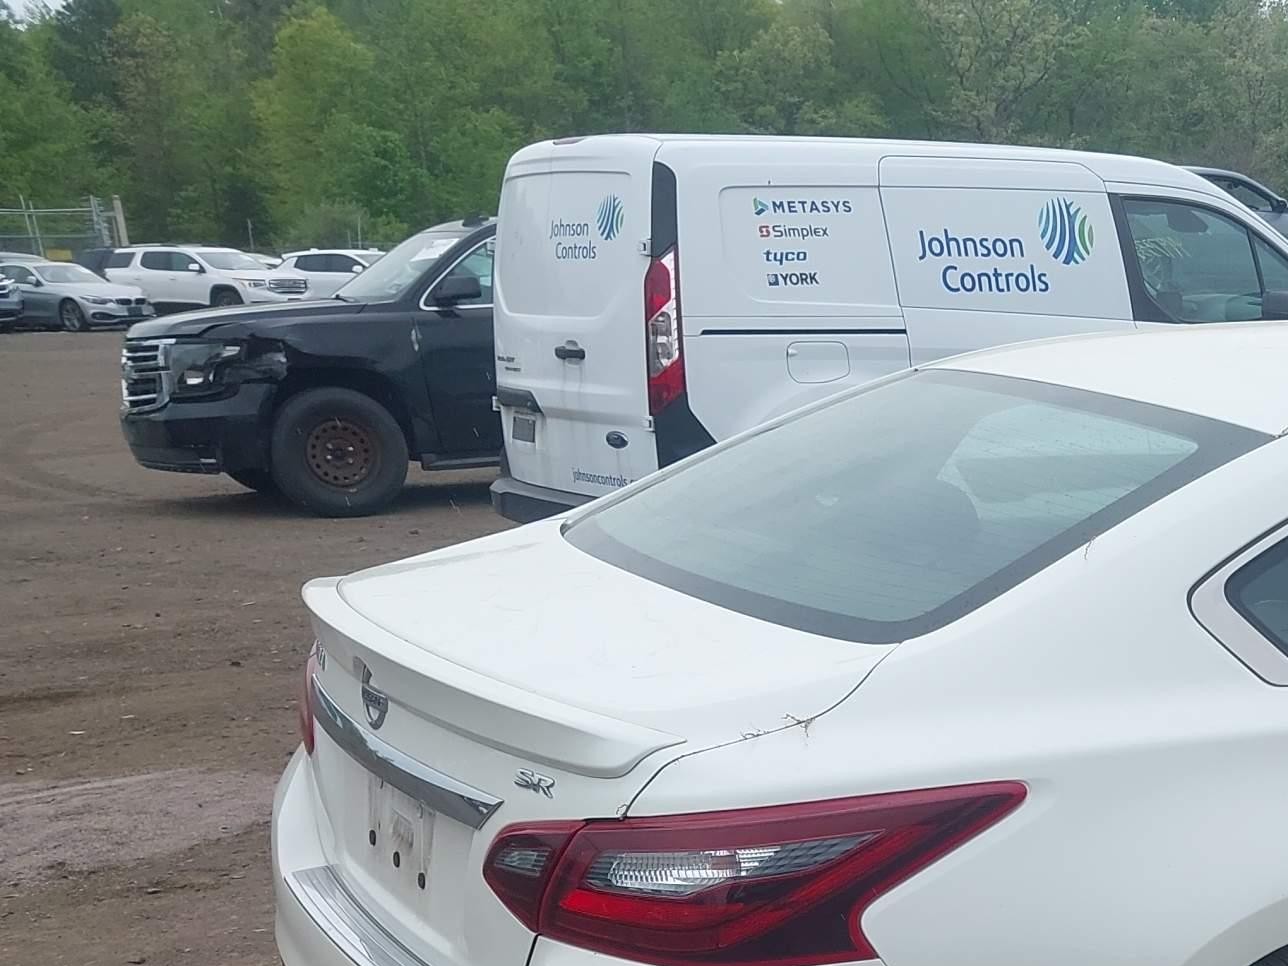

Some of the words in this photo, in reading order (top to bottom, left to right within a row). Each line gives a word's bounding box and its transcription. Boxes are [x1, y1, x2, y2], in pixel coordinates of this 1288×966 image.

[771, 200, 852, 213] METASYS
[549, 218, 589, 240] Johnson
[772, 224, 829, 240] Simplex
[555, 240, 596, 259] Controls
[918, 229, 1025, 261] Johnson
[763, 250, 807, 265] tyco
[779, 272, 819, 286] YORK
[942, 264, 1049, 292] Controls
[513, 768, 555, 799] SR
